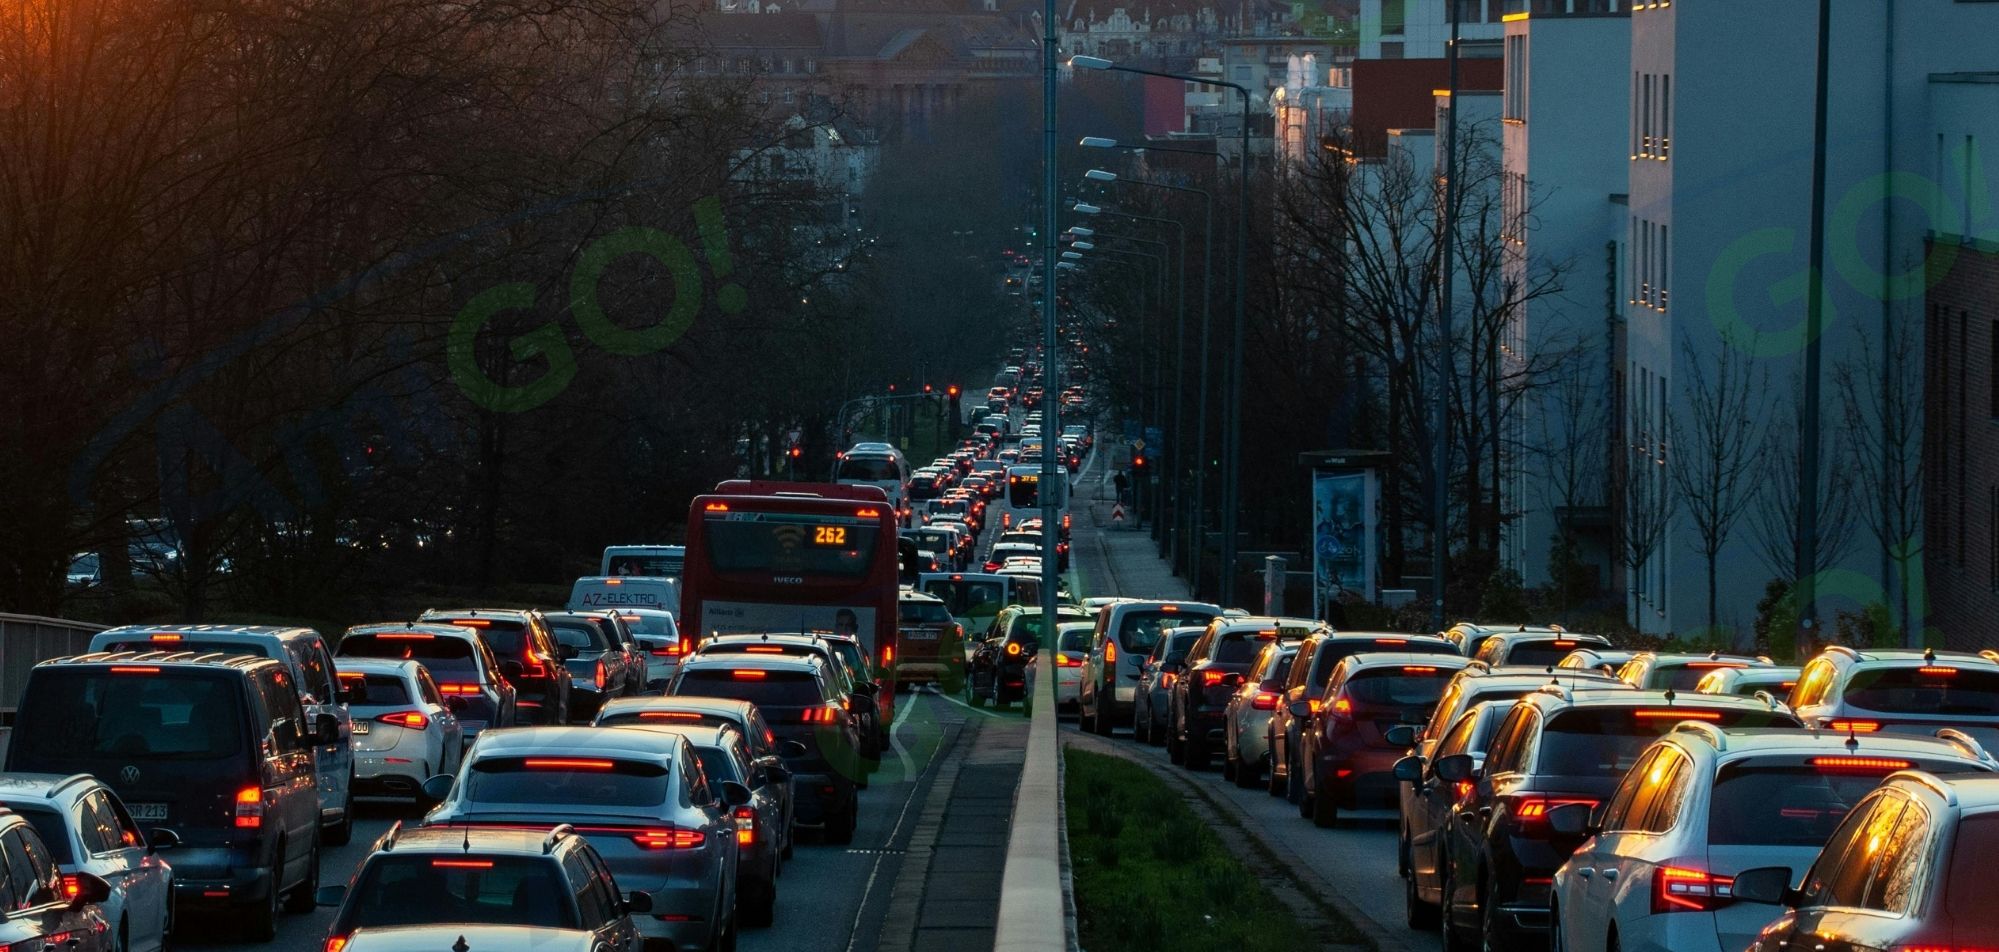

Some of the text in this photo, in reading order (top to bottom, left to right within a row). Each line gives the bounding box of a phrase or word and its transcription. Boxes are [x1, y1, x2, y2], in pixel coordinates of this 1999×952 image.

[814, 526, 847, 545] 262
[774, 576, 803, 584] IVECO
[145, 804, 167, 818] 213
